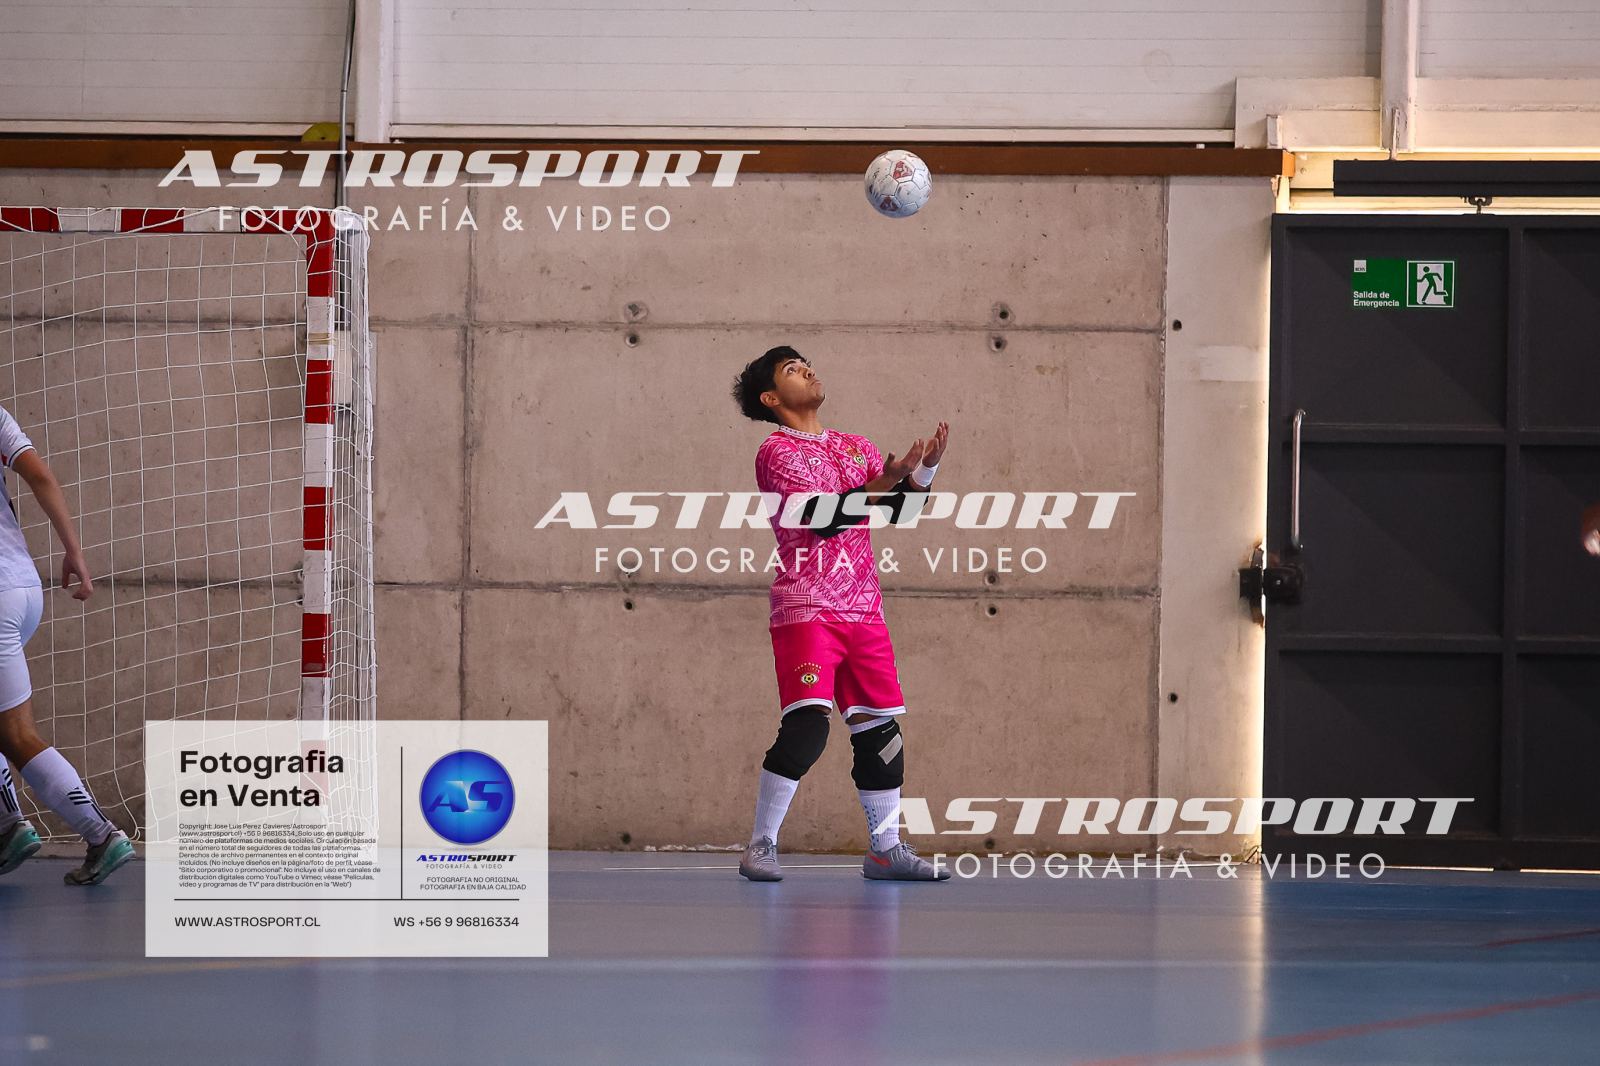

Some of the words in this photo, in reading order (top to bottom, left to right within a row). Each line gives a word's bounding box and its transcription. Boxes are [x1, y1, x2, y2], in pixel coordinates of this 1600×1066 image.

[1353, 291, 1378, 299] Salida
[1379, 291, 1390, 299] de
[1353, 299, 1400, 308] Emergencia
